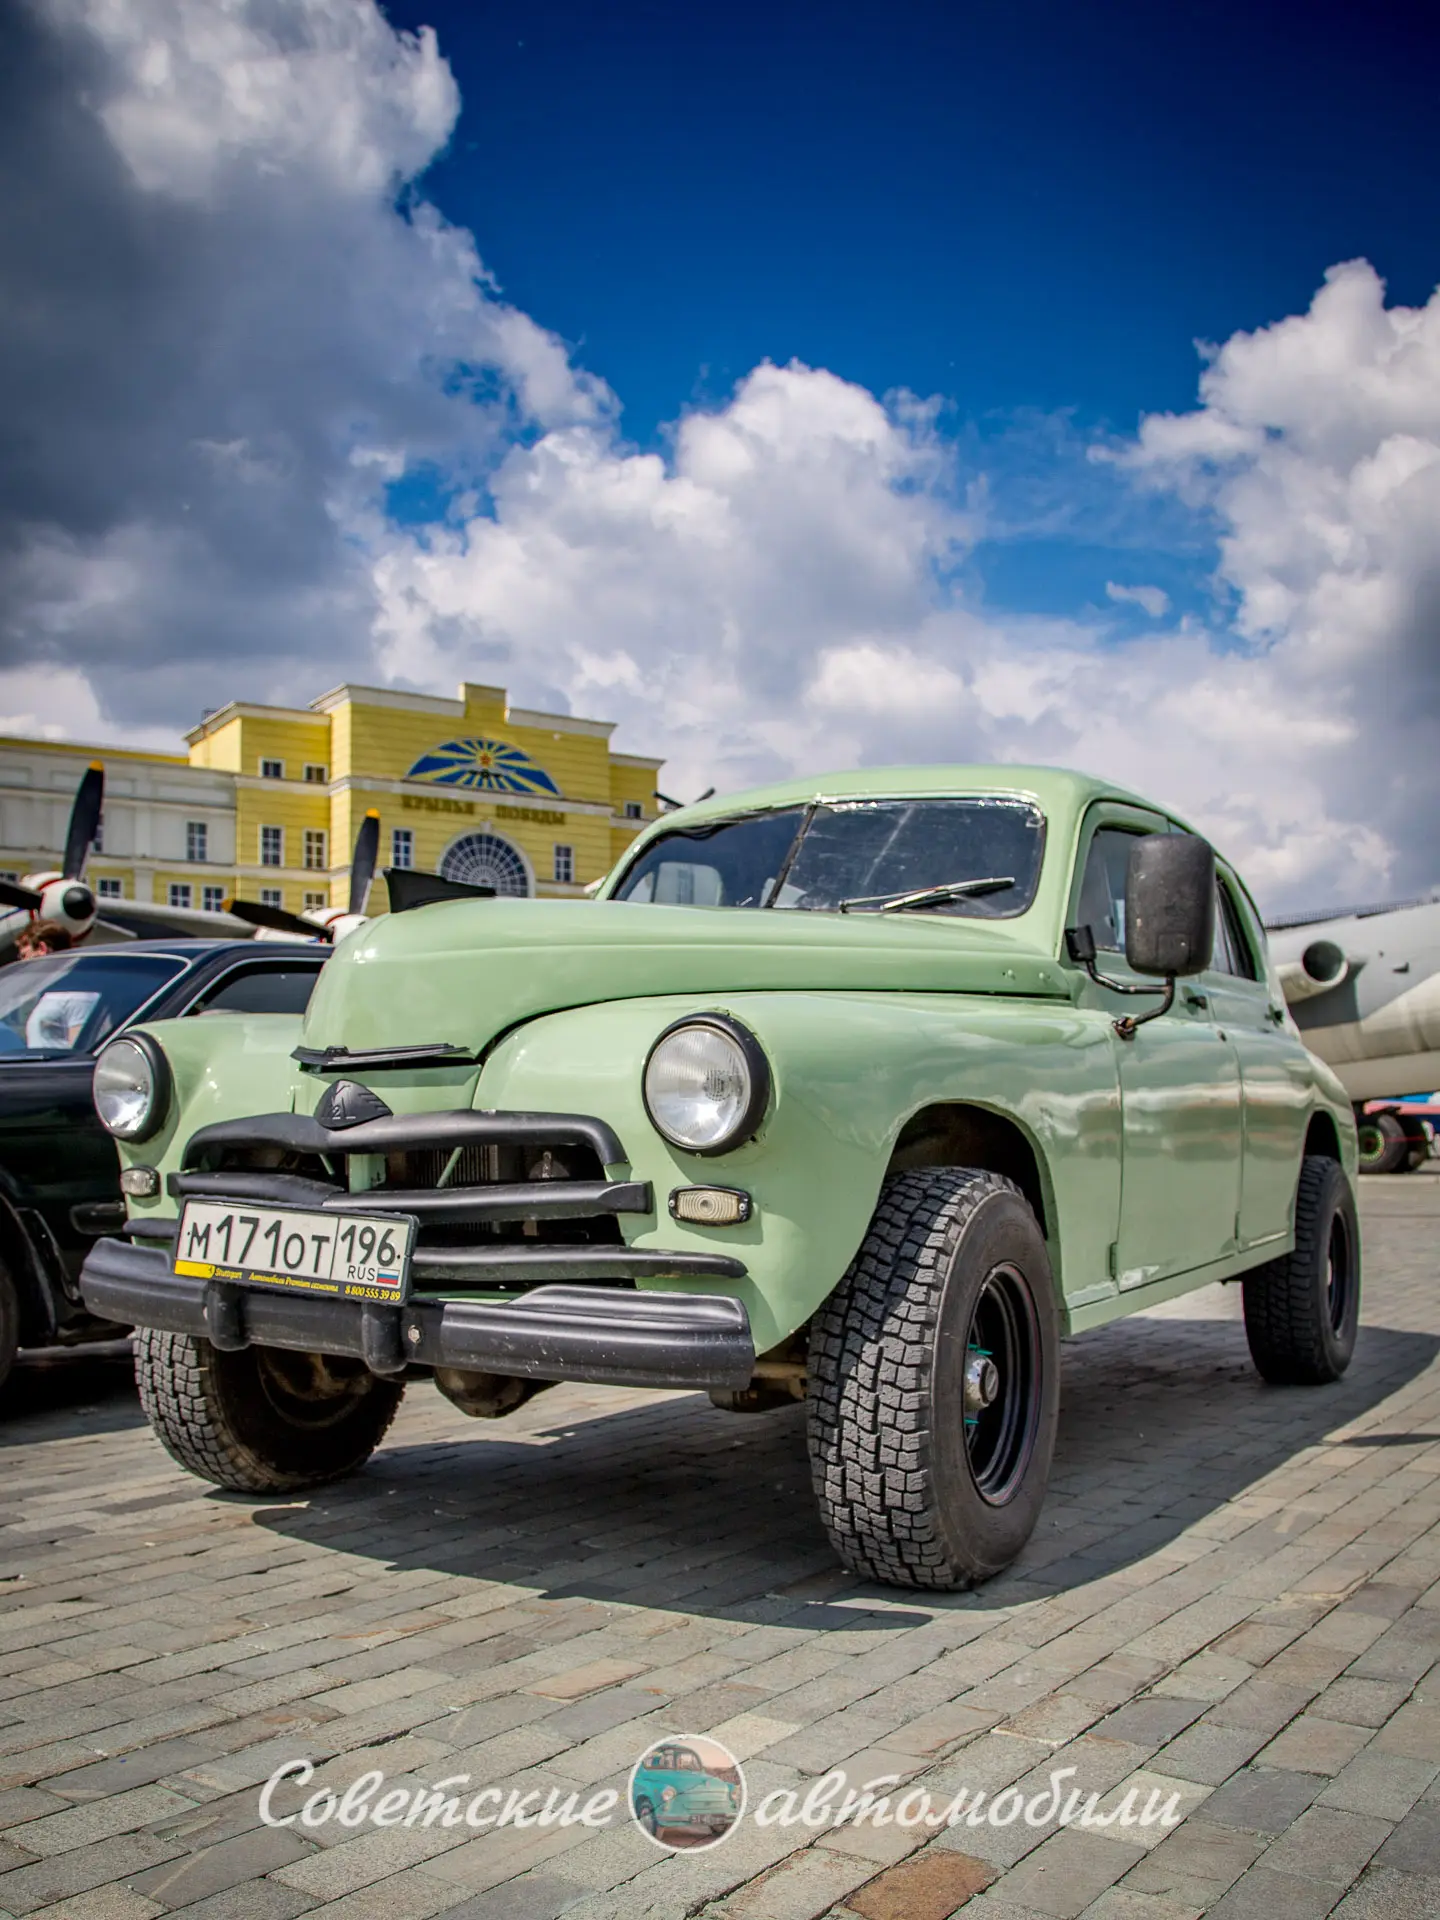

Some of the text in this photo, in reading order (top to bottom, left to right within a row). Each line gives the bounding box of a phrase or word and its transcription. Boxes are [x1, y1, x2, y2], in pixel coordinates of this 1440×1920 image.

[340, 1224, 396, 1267] 196
[347, 1265, 376, 1282] RUS
[345, 1285, 401, 1301] 8 800 555 39 89
